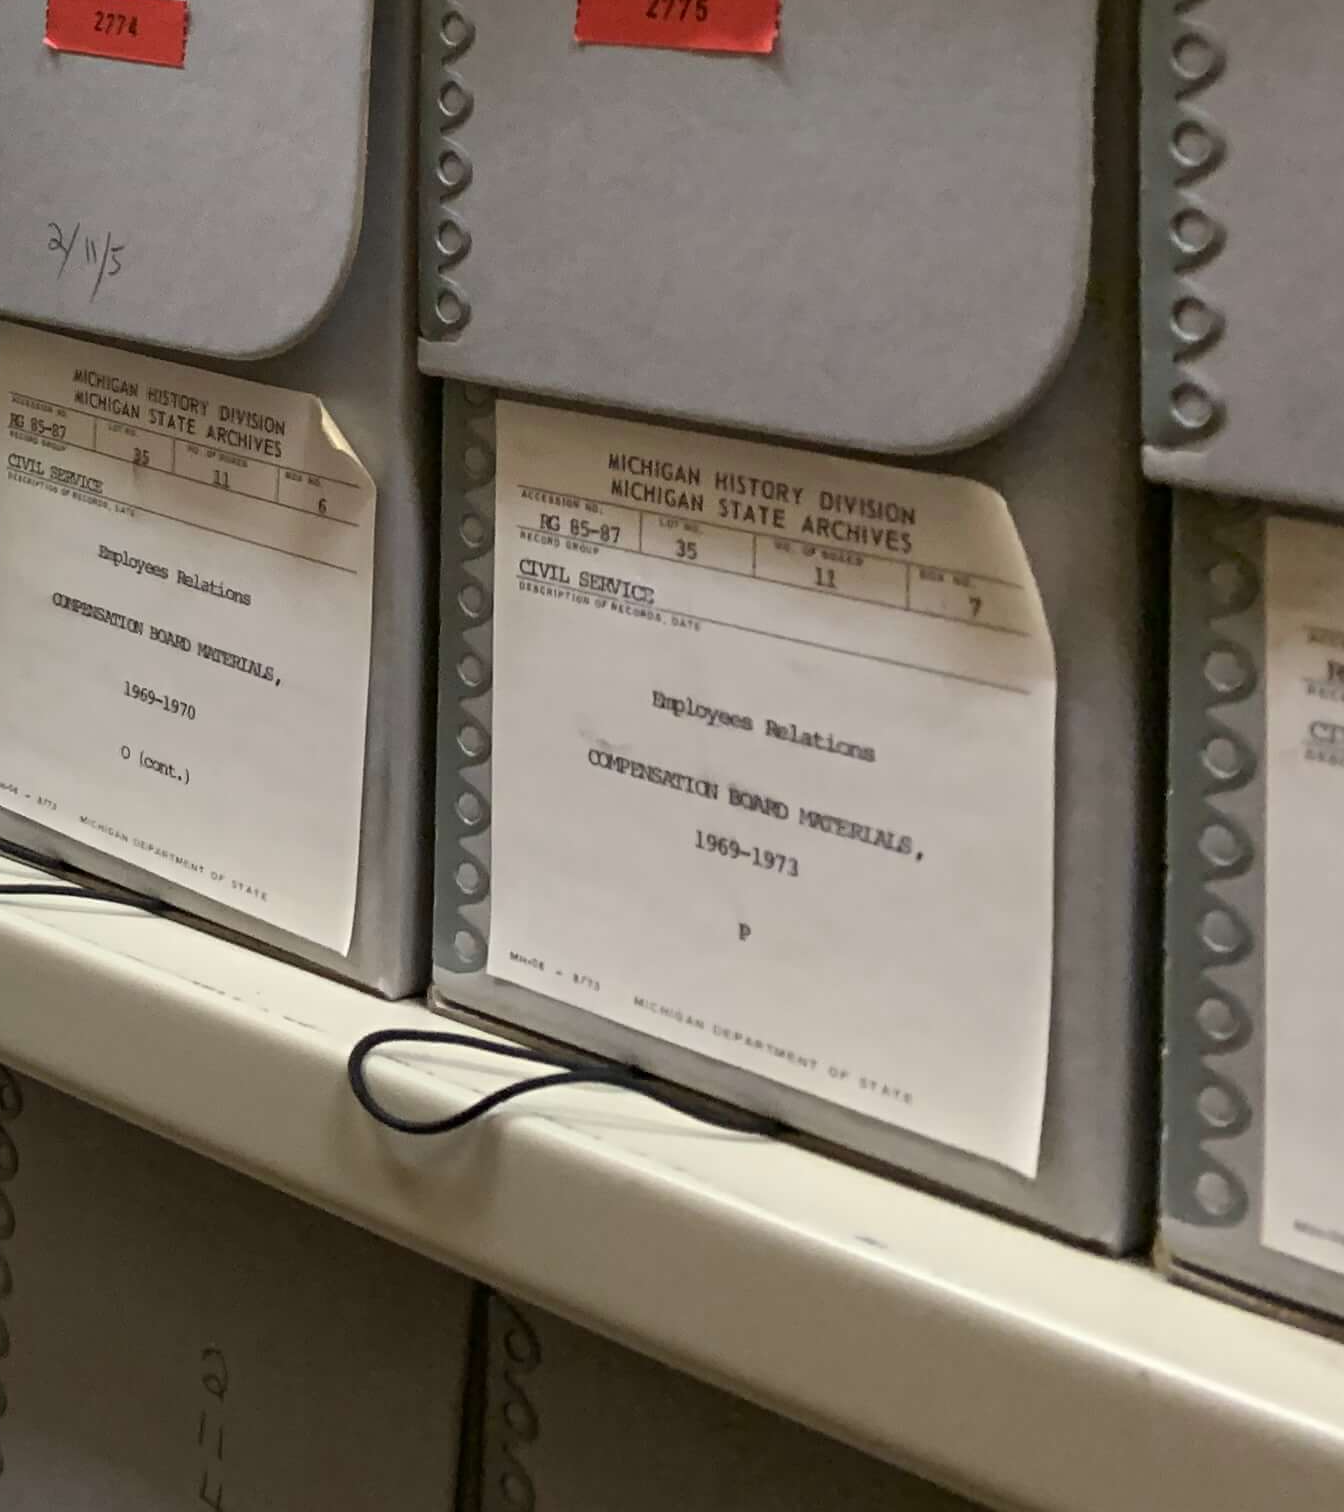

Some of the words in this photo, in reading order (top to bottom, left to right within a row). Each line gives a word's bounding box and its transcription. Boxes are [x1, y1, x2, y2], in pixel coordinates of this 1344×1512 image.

[93, 11, 139, 37] 2774
[47, 221, 125, 304] 2/11/5
[72, 368, 139, 399] MICHIGAN
[147, 387, 209, 416] HISTORY
[219, 405, 287, 436] DIVISION
[8, 412, 25, 430] RG
[30, 417, 67, 440] 85-87
[74, 391, 141, 420] MICHIGAN
[149, 411, 196, 435] STATE
[206, 424, 283, 458] ARCHIVES
[7, 452, 45, 477] CIVIL
[50, 464, 104, 494] SERVICE
[133, 447, 150, 467] 35
[214, 471, 230, 490] 11
[608, 453, 702, 488] MICHIGAN
[714, 472, 804, 506] HISTORY
[820, 491, 918, 527] DIVISION
[317, 498, 328, 515] 6
[611, 477, 705, 513] MICHIGAN
[718, 500, 786, 530] STATE
[801, 516, 914, 554] ARCHIVES
[539, 513, 561, 534] RG
[569, 516, 622, 545] 85-87
[675, 539, 699, 561] 35
[98, 544, 169, 580] Employees
[177, 570, 252, 606] Relations
[518, 559, 571, 586] CIVIL
[578, 569, 657, 606] SERVICE
[814, 566, 838, 589] 11
[968, 596, 983, 618] 7
[52, 591, 144, 636] COMPENSATION
[149, 626, 192, 653] BOARD
[197, 642, 282, 687] MATERIALS,
[123, 681, 197, 721] 1969-1970
[652, 689, 754, 732] Employees
[765, 718, 877, 763] Relations
[139, 751, 191, 785] (cont.)
[587, 747, 719, 801] COMPENSATION
[728, 787, 790, 821] BOARD
[798, 807, 925, 862] MATERIALS,
[694, 829, 801, 879] 1969-1973
[738, 923, 753, 942] P
[633, 995, 706, 1031] MICHIGAN
[712, 1024, 820, 1072] DEPARTMENT
[827, 1064, 850, 1081] OF
[858, 1077, 914, 1105] STATE
